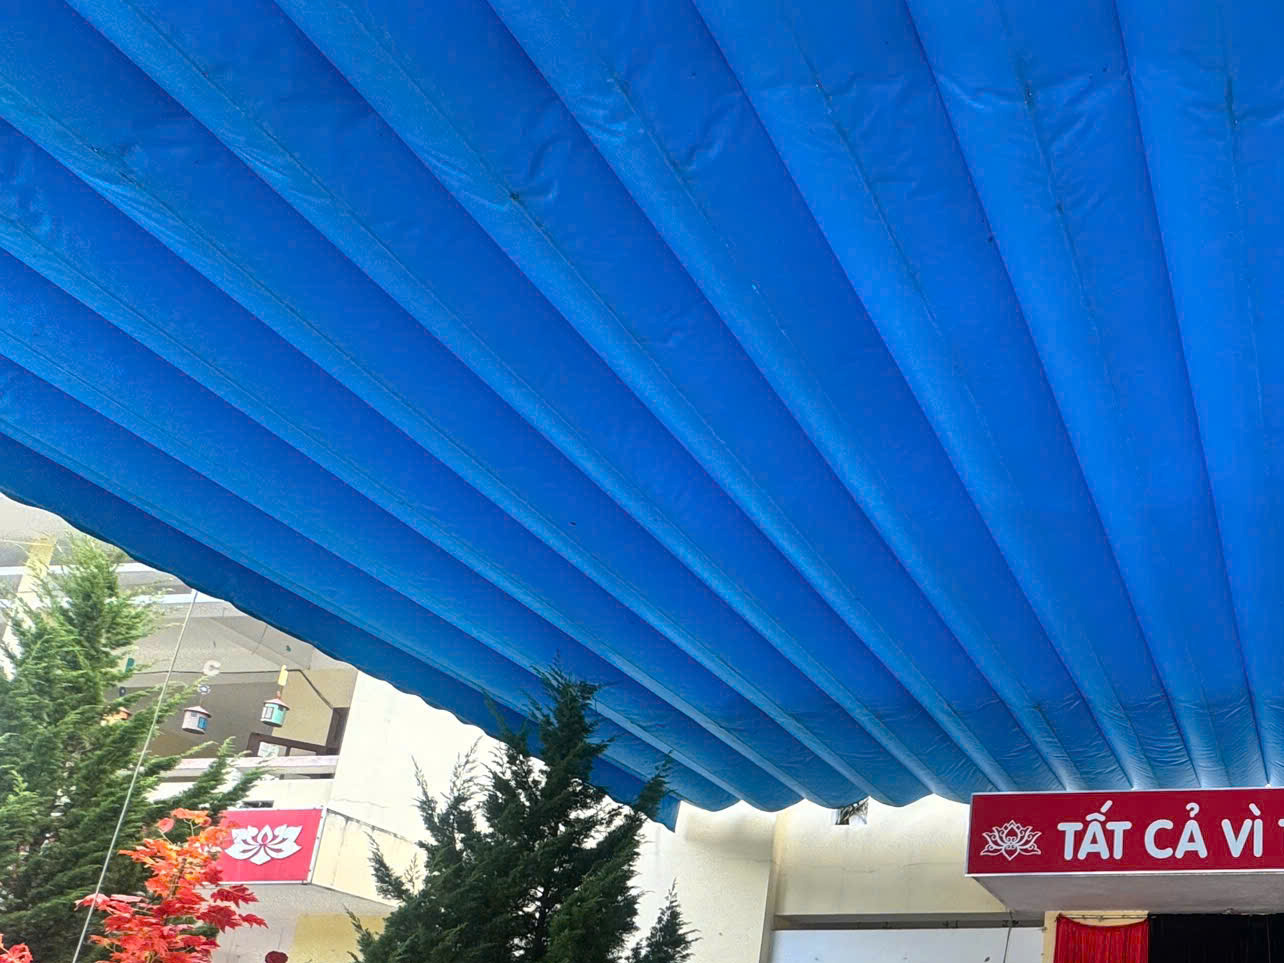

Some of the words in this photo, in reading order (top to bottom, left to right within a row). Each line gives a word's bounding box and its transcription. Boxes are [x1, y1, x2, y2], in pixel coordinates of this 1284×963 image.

[1057, 799, 1132, 860] TẤT
[1144, 802, 1208, 859] CẢ
[1221, 803, 1263, 858] VÌ
